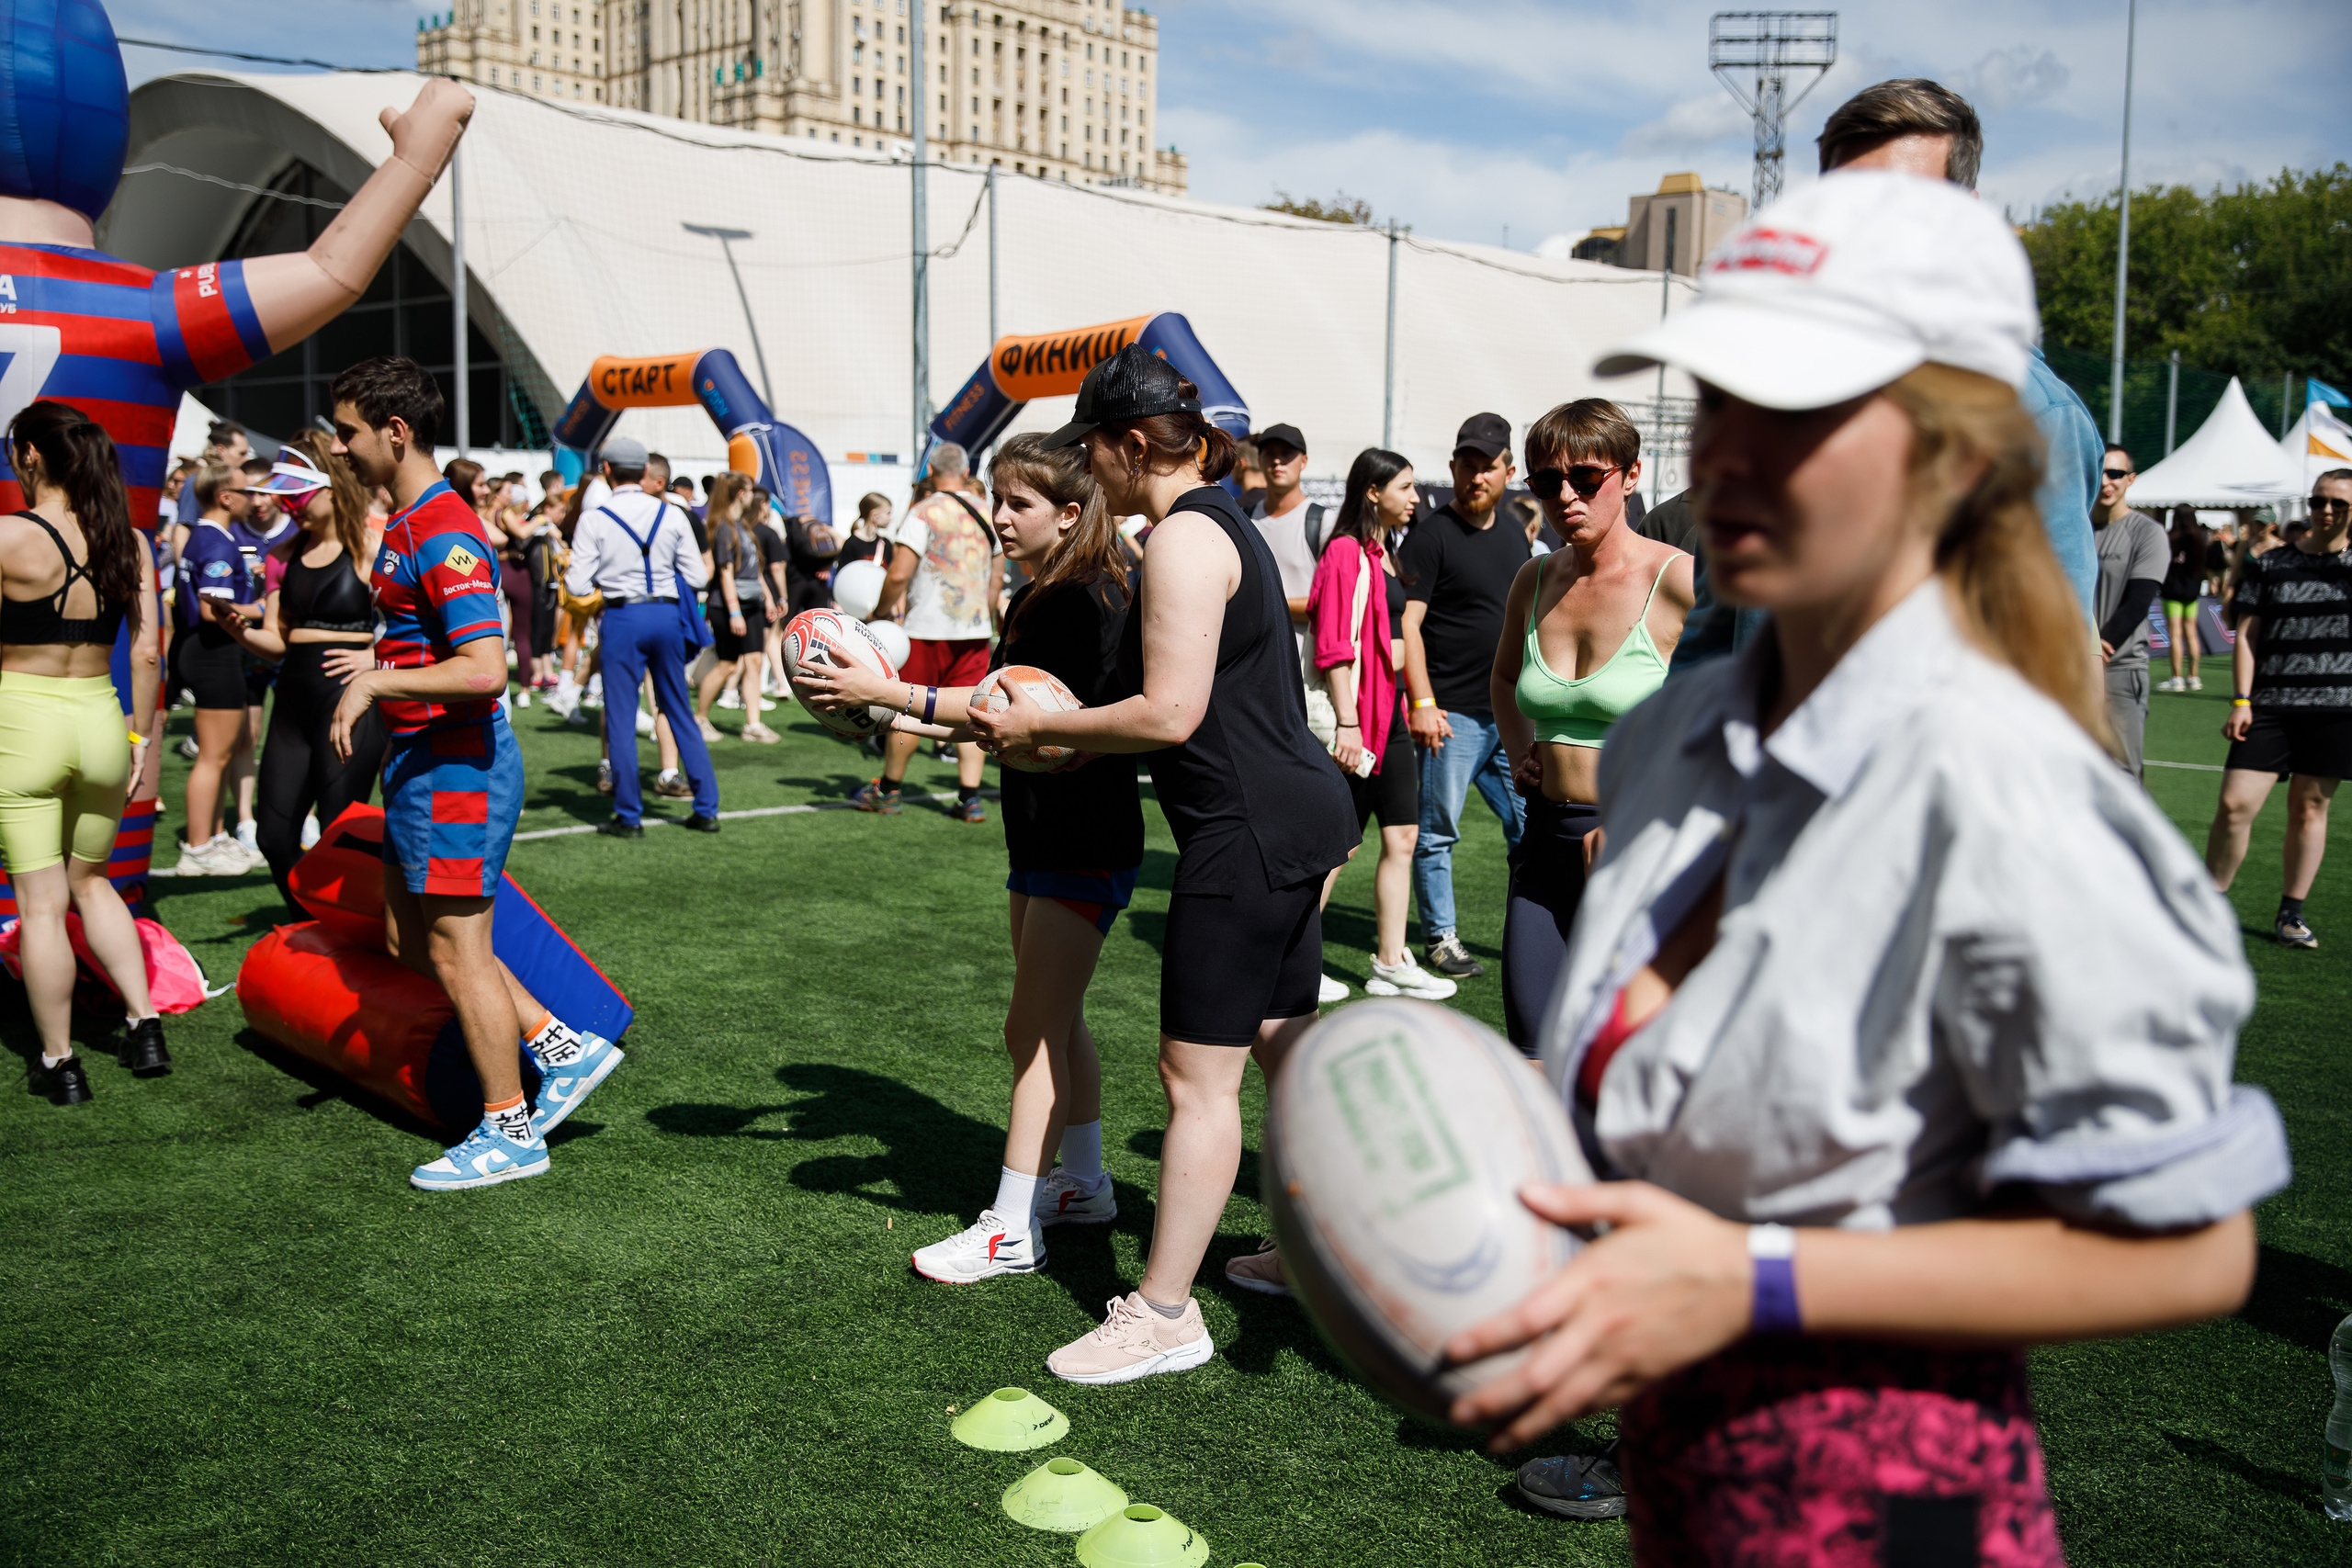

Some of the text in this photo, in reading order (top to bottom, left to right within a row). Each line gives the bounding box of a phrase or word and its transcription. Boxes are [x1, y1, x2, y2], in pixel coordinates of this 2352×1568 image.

[1001, 327, 1127, 378] ФИНИШ
[602, 364, 677, 396] СТАРТ
[944, 381, 985, 433] FITNESS
[854, 626, 883, 650] RUGBY
